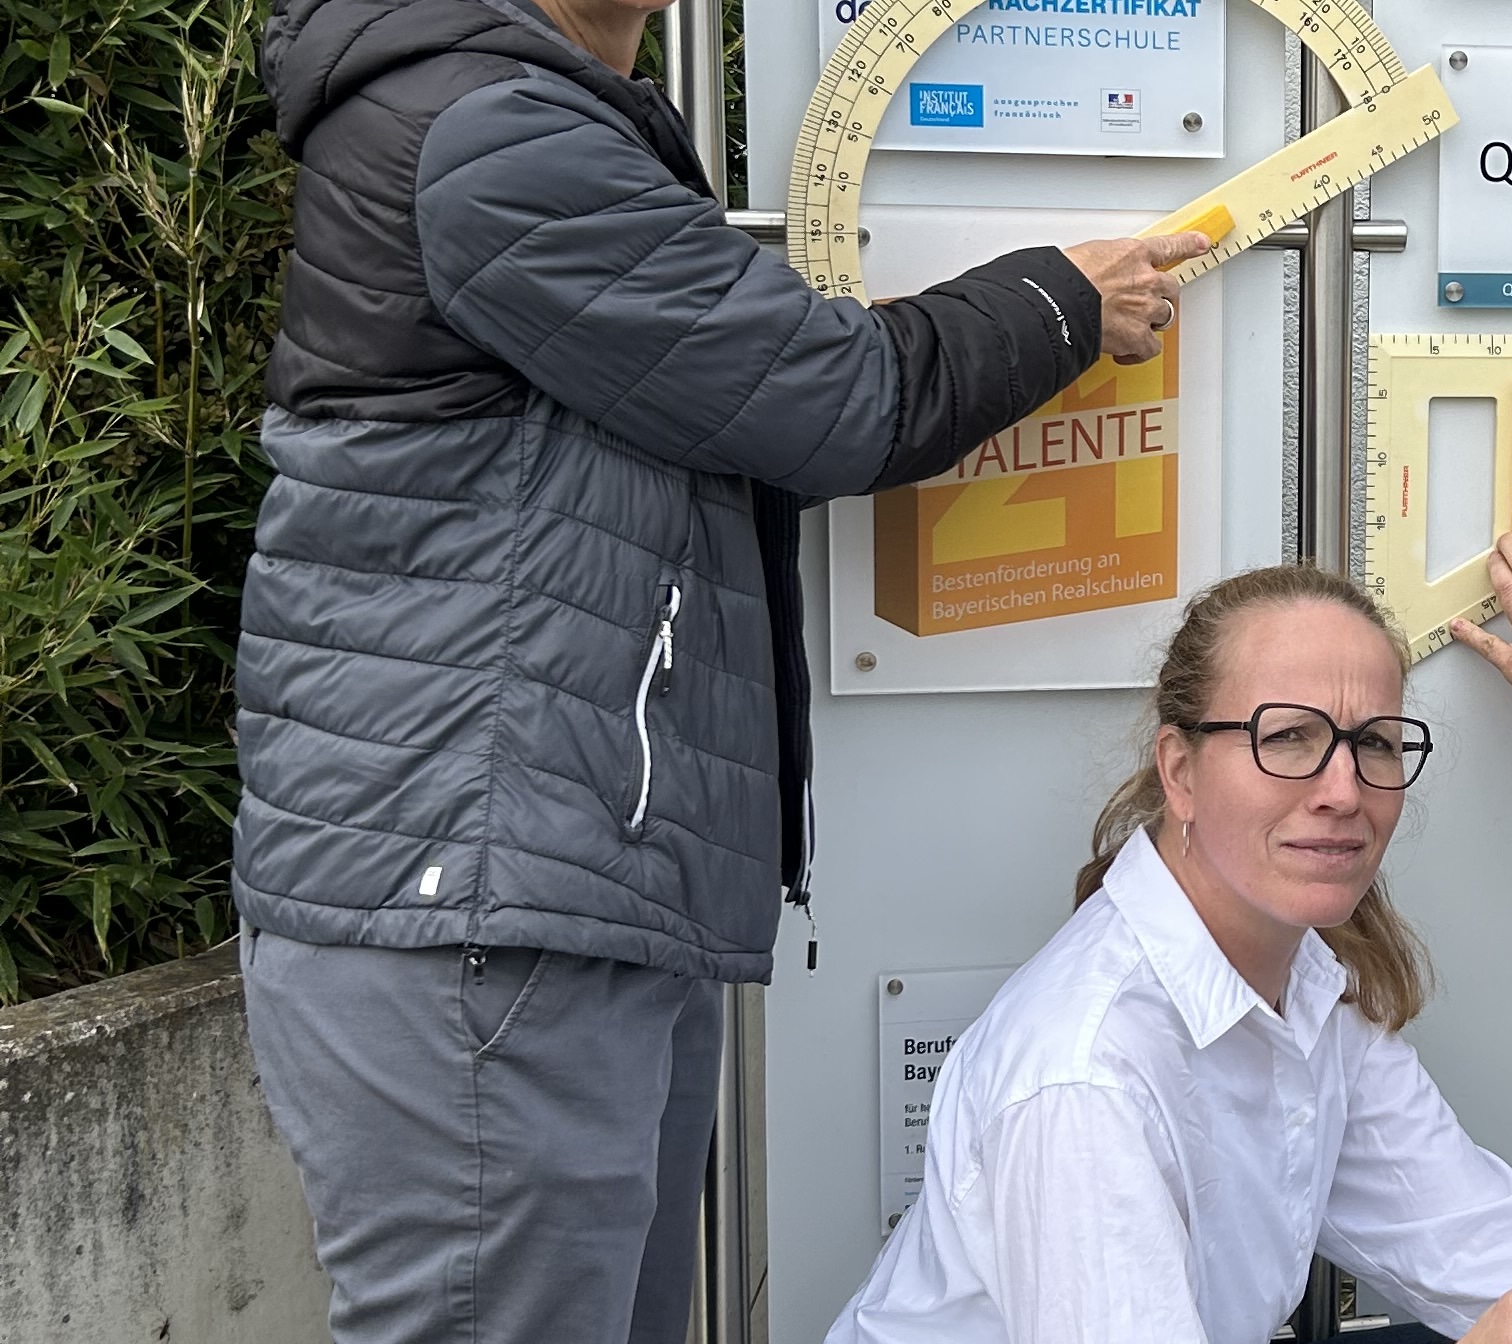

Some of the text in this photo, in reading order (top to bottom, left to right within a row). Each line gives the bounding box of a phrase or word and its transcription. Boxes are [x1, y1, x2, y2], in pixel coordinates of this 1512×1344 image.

[1299, 11, 1320, 33] 160
[895, 33, 915, 54] 70
[957, 24, 1181, 50] PARTNERSCHULE
[1350, 36, 1366, 55] 10
[1333, 48, 1352, 71] 170
[847, 60, 866, 83] 120
[868, 75, 885, 95] 60
[920, 90, 968, 105] INSTITUT
[994, 99, 1079, 108] ausgesprochen
[994, 110, 1063, 119] französisch
[1421, 109, 1441, 126] 50
[847, 121, 863, 143] 50
[837, 171, 849, 192] 40
[1313, 174, 1331, 190] 40
[834, 223, 845, 243] 30
[838, 274, 852, 294] 20
[1487, 346, 1502, 355] 10
[1378, 452, 1388, 467] 10
[1377, 515, 1386, 531] 15
[932, 552, 1121, 594] Bestenförderung an
[932, 572, 1164, 621] Bayerischen Realschulen
[1376, 577, 1385, 596] 20
[904, 1064, 941, 1083] Bay
